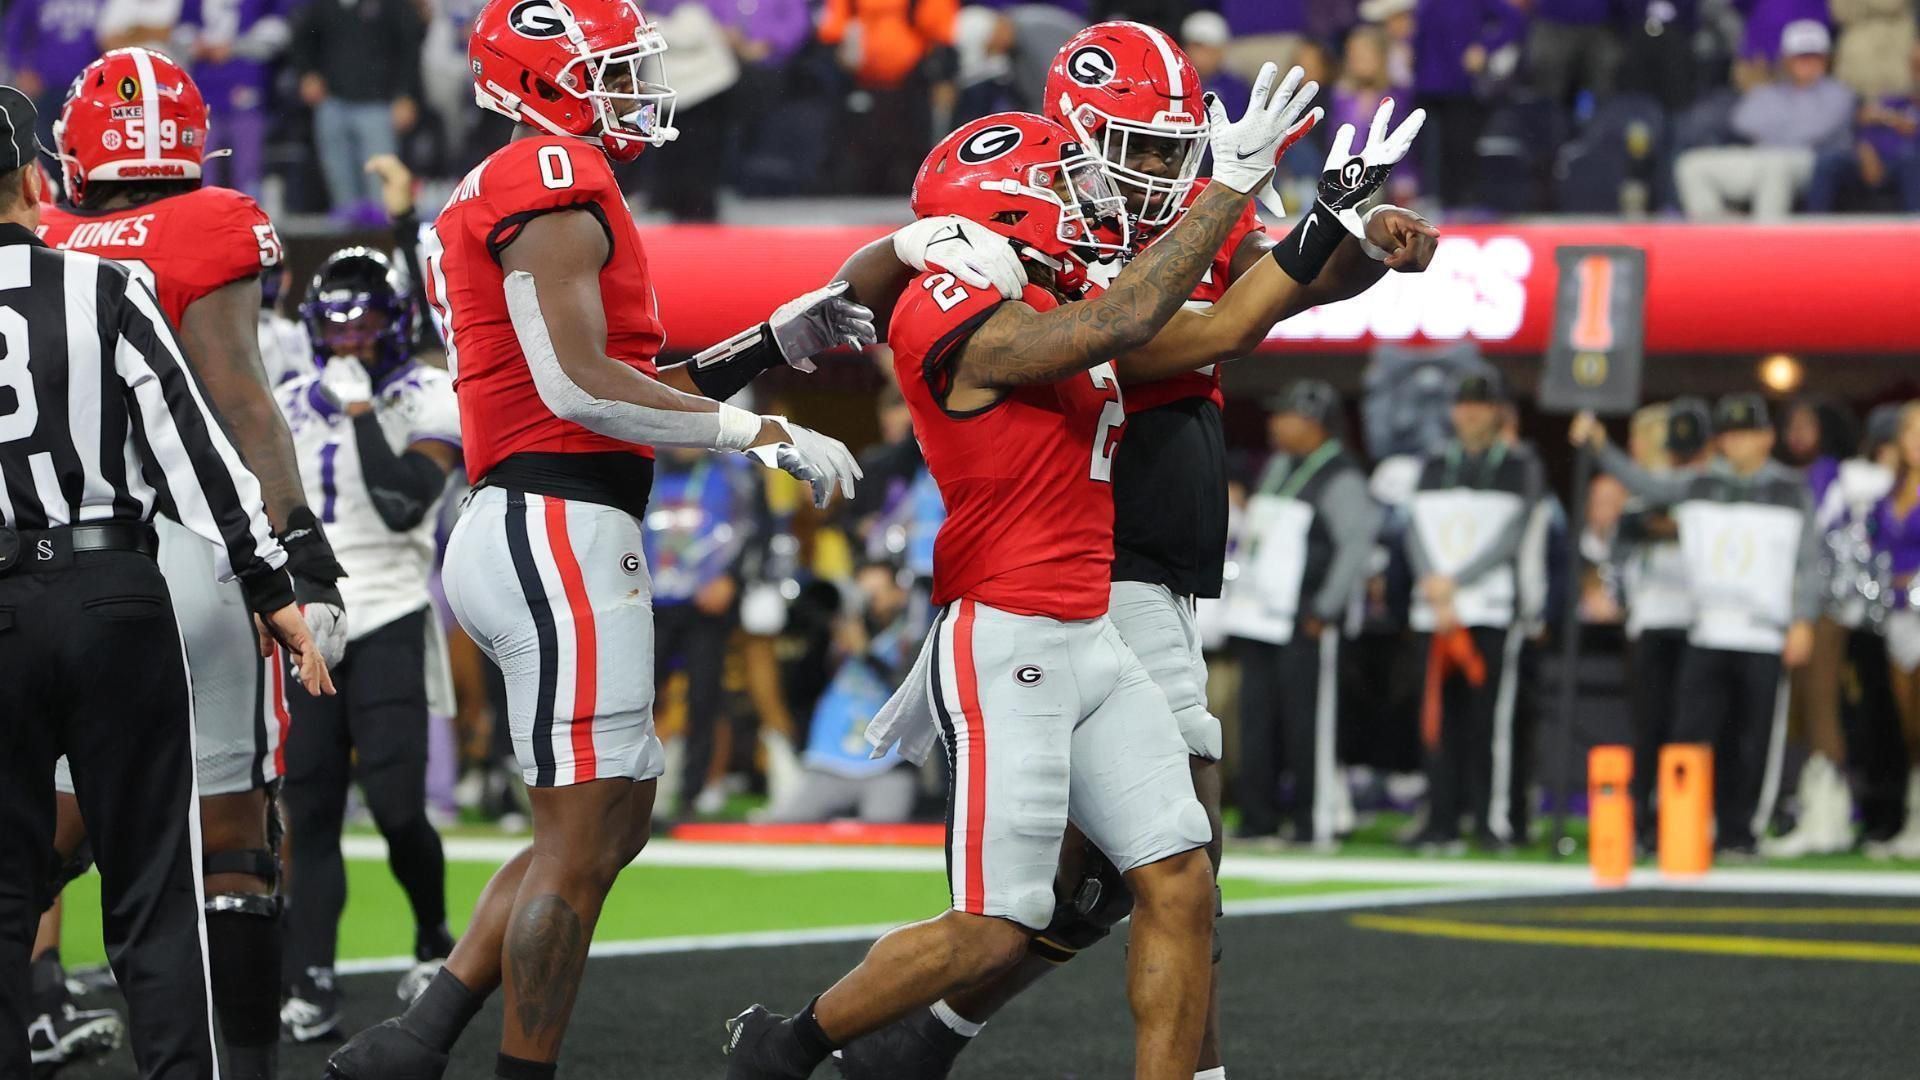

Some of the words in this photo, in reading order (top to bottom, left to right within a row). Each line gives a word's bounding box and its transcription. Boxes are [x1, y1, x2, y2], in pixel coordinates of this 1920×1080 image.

[125, 119, 177, 150] 59
[118, 165, 184, 177] GEORGIA
[537, 144, 574, 190] 0
[56, 213, 155, 250] JONES
[252, 221, 284, 267] 5
[922, 272, 969, 313] 2
[1570, 255, 1615, 351] 1
[1088, 358, 1127, 484] 2
[320, 443, 340, 524] 1
[37, 539, 55, 561] S
